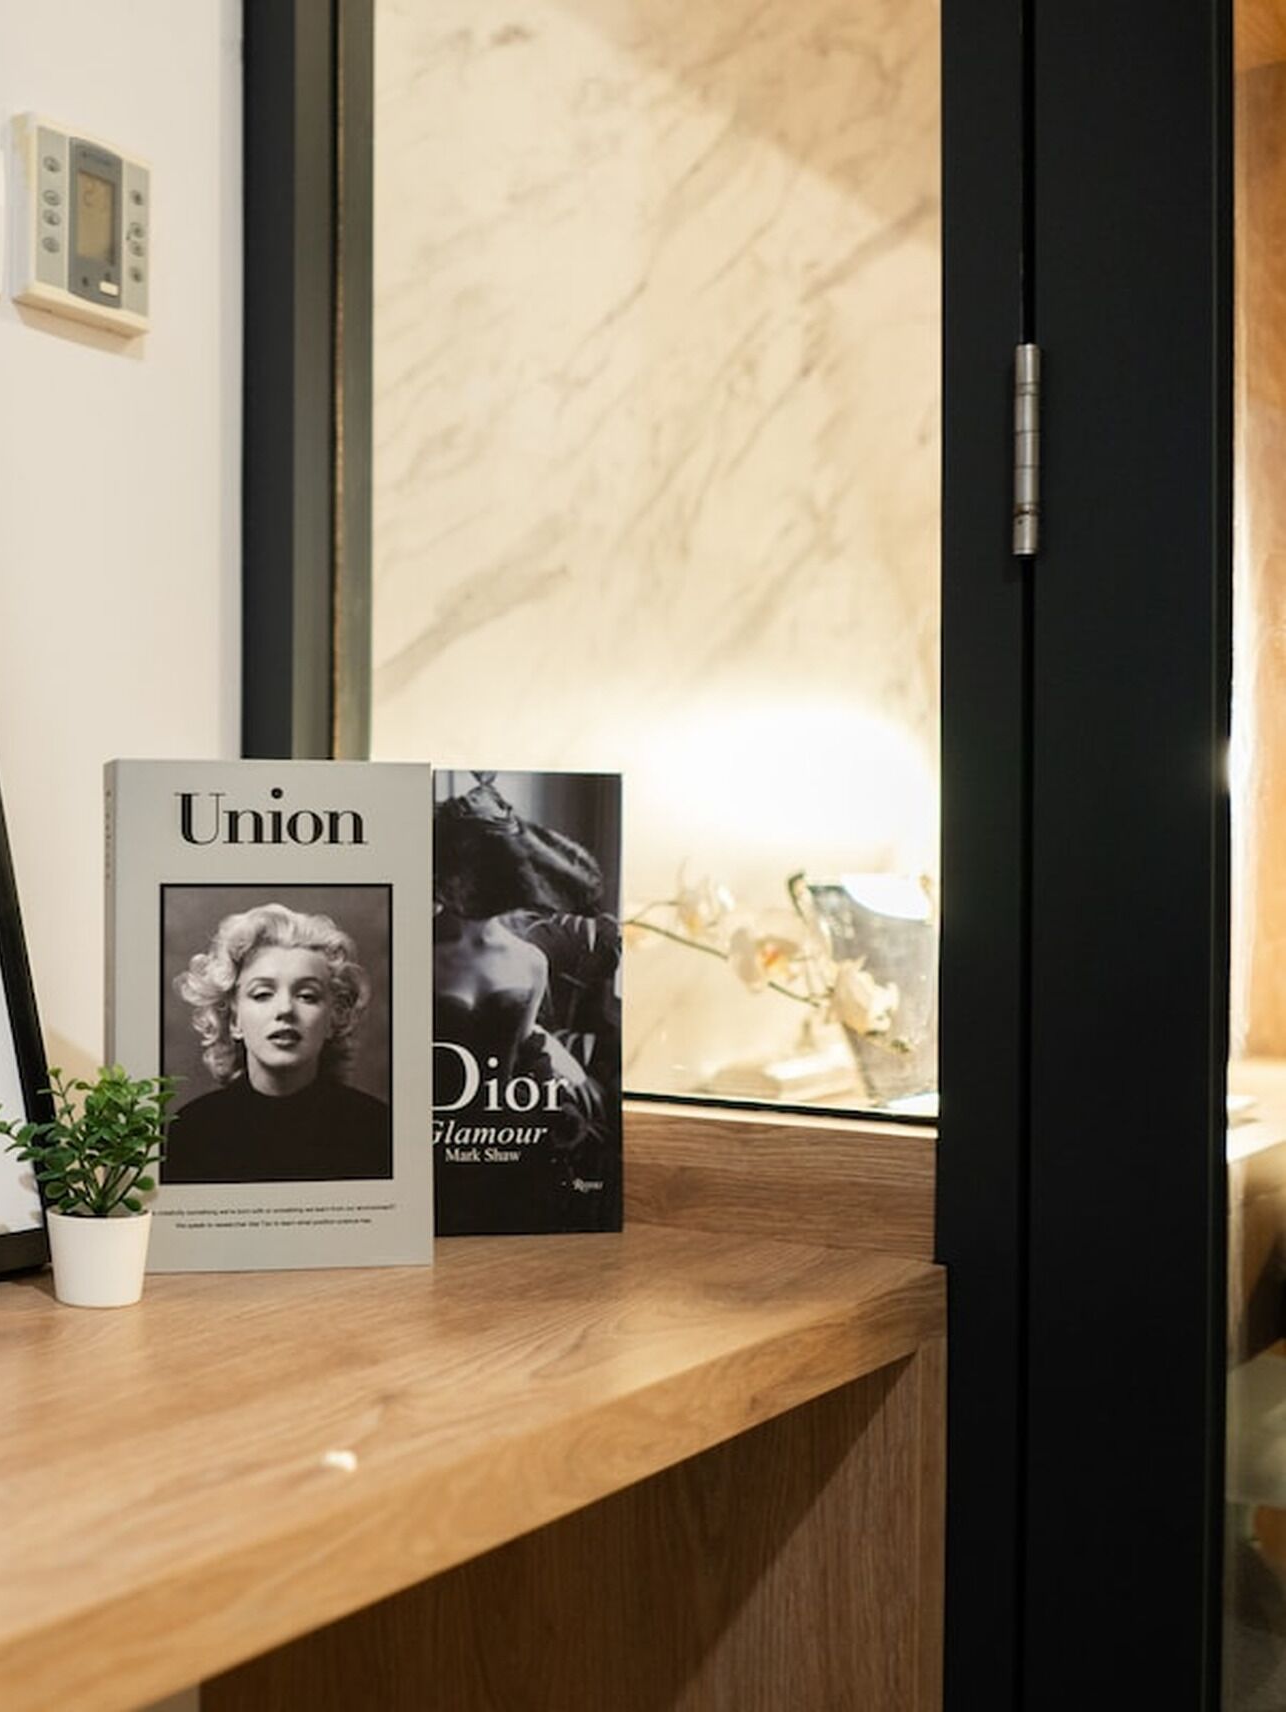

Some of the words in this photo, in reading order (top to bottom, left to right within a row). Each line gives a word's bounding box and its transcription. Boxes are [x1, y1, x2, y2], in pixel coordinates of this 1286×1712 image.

[174, 787, 369, 845] Union
[432, 1041, 569, 1112] Dior
[445, 1147, 481, 1162] Mark
[483, 1147, 521, 1162] Shaw
